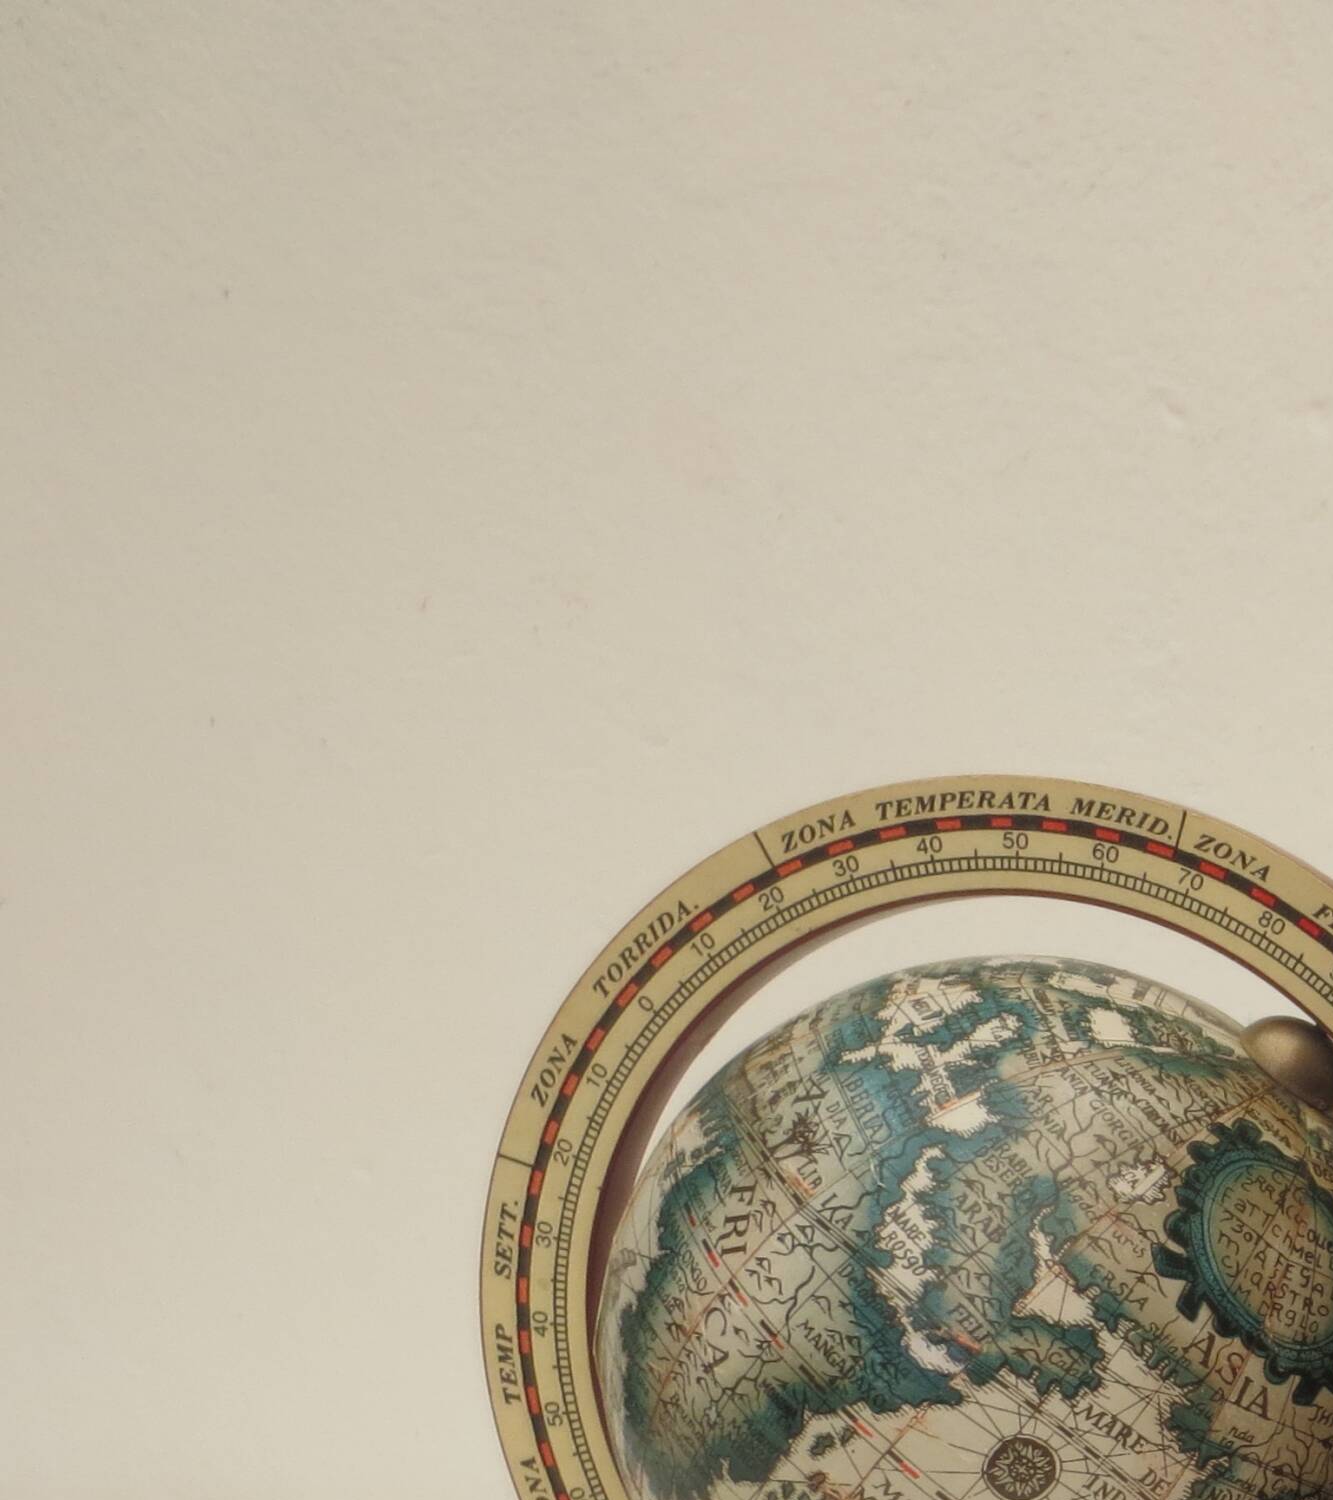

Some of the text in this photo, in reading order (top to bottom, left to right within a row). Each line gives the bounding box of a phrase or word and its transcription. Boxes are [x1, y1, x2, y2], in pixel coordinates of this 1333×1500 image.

[781, 790, 1173, 854] ZONA TEMPERATA MERID.
[916, 835, 943, 854] 40
[1002, 832, 1029, 850] 50
[1092, 843, 1120, 864] 60
[833, 855, 860, 877] 30
[1193, 834, 1273, 883] ZONA
[1177, 867, 1204, 892] 70
[758, 886, 785, 911] 20
[1258, 910, 1286, 936] 80
[691, 933, 716, 958] 10
[530, 900, 699, 1109] ZONA TORRIDA.
[637, 995, 655, 1014] 0
[586, 1063, 608, 1089] 10
[553, 1138, 574, 1168] 20
[494, 1199, 519, 1280] SETT.
[536, 1221, 554, 1248] 30
[533, 1311, 550, 1338] 40
[495, 1324, 522, 1406] TEMP
[547, 1401, 564, 1428] 50
[1073, 1399, 1173, 1497] MARE DE
